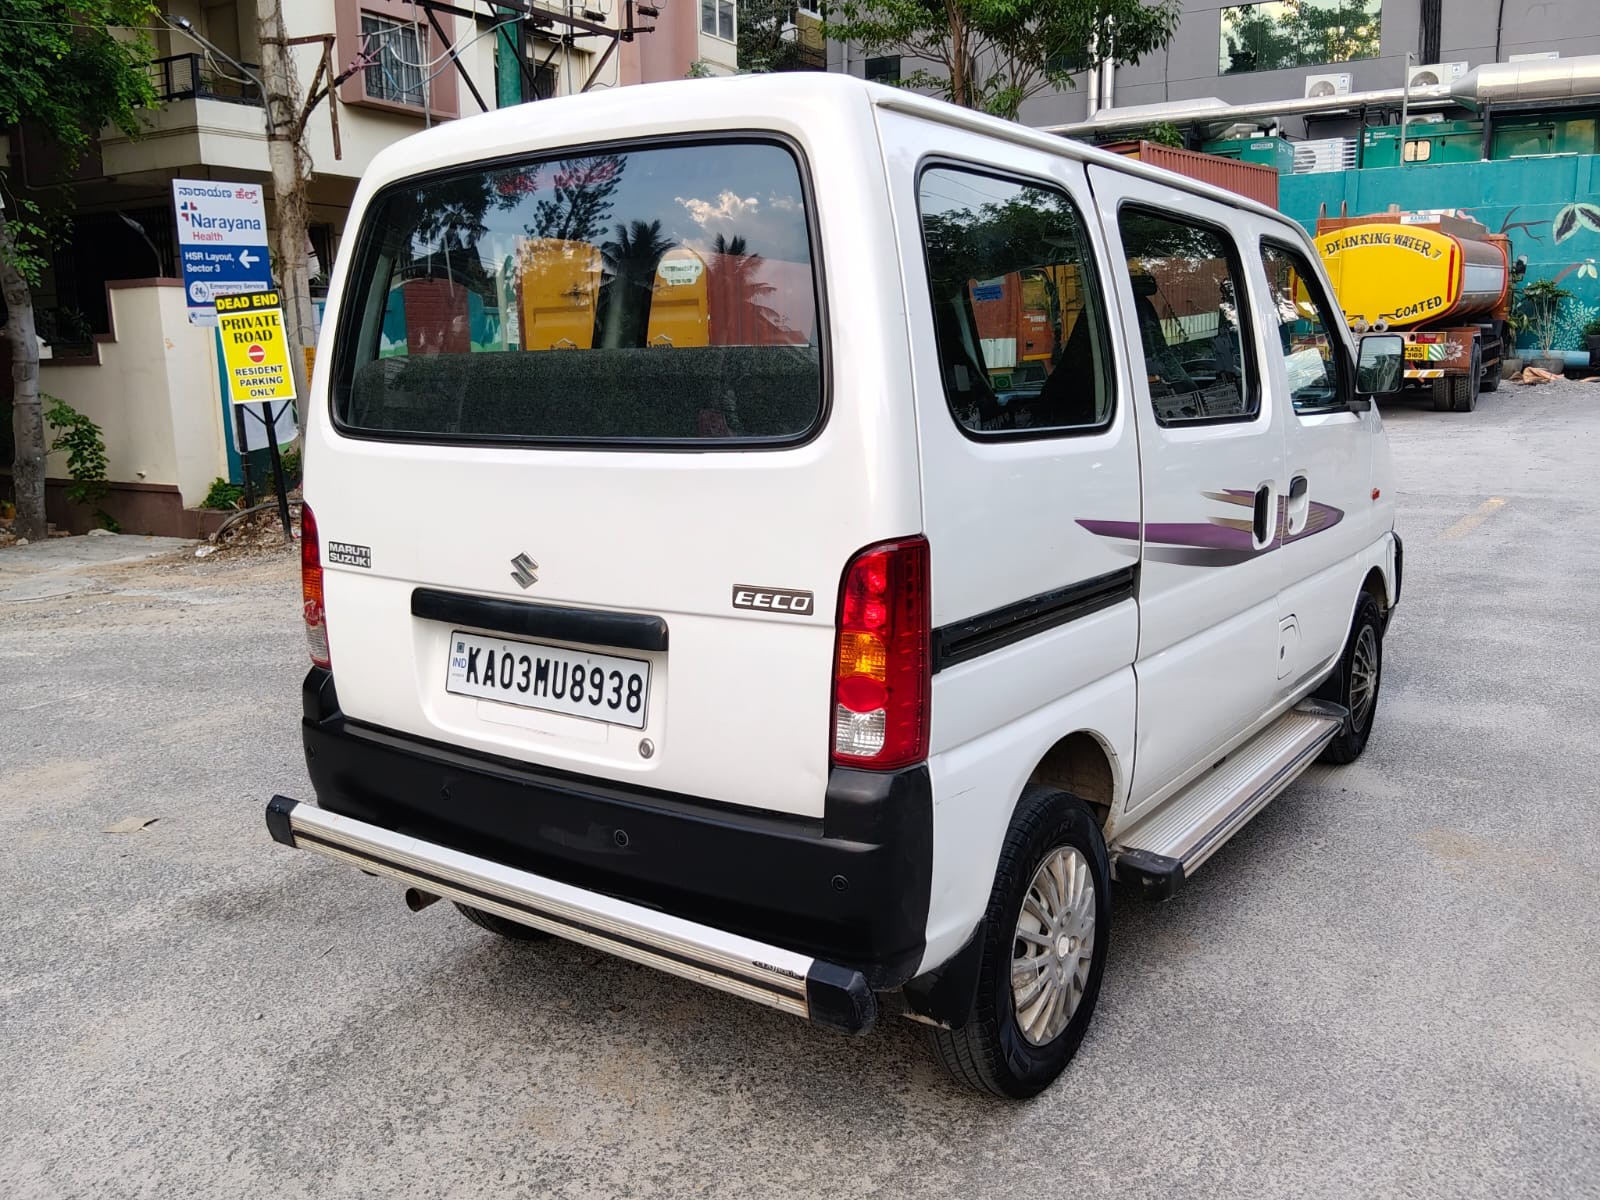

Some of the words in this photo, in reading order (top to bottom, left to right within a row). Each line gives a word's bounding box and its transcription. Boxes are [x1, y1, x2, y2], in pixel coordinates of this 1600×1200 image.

[191, 213, 261, 232] Narayana
[192, 232, 223, 241] Health
[1326, 232, 1391, 255] DRINKING
[1393, 233, 1431, 257] WATER
[185, 252, 204, 260] HSR
[205, 253, 234, 262] Layout,
[187, 264, 213, 272] Sector
[214, 264, 221, 272] 3
[216, 297, 250, 310] DEAD
[252, 294, 278, 306] END
[1395, 296, 1442, 319] COATED
[222, 314, 281, 331] PRIVATE
[233, 329, 273, 344] ROAD
[235, 365, 283, 376] RESIDENT
[240, 376, 284, 387] PARKING
[250, 387, 276, 397] ONLY
[330, 542, 370, 557] MARUTI
[330, 552, 370, 567] SUZUKI
[734, 591, 811, 611] EECO
[452, 656, 467, 669] IND
[465, 646, 643, 713] KA03MU8938
